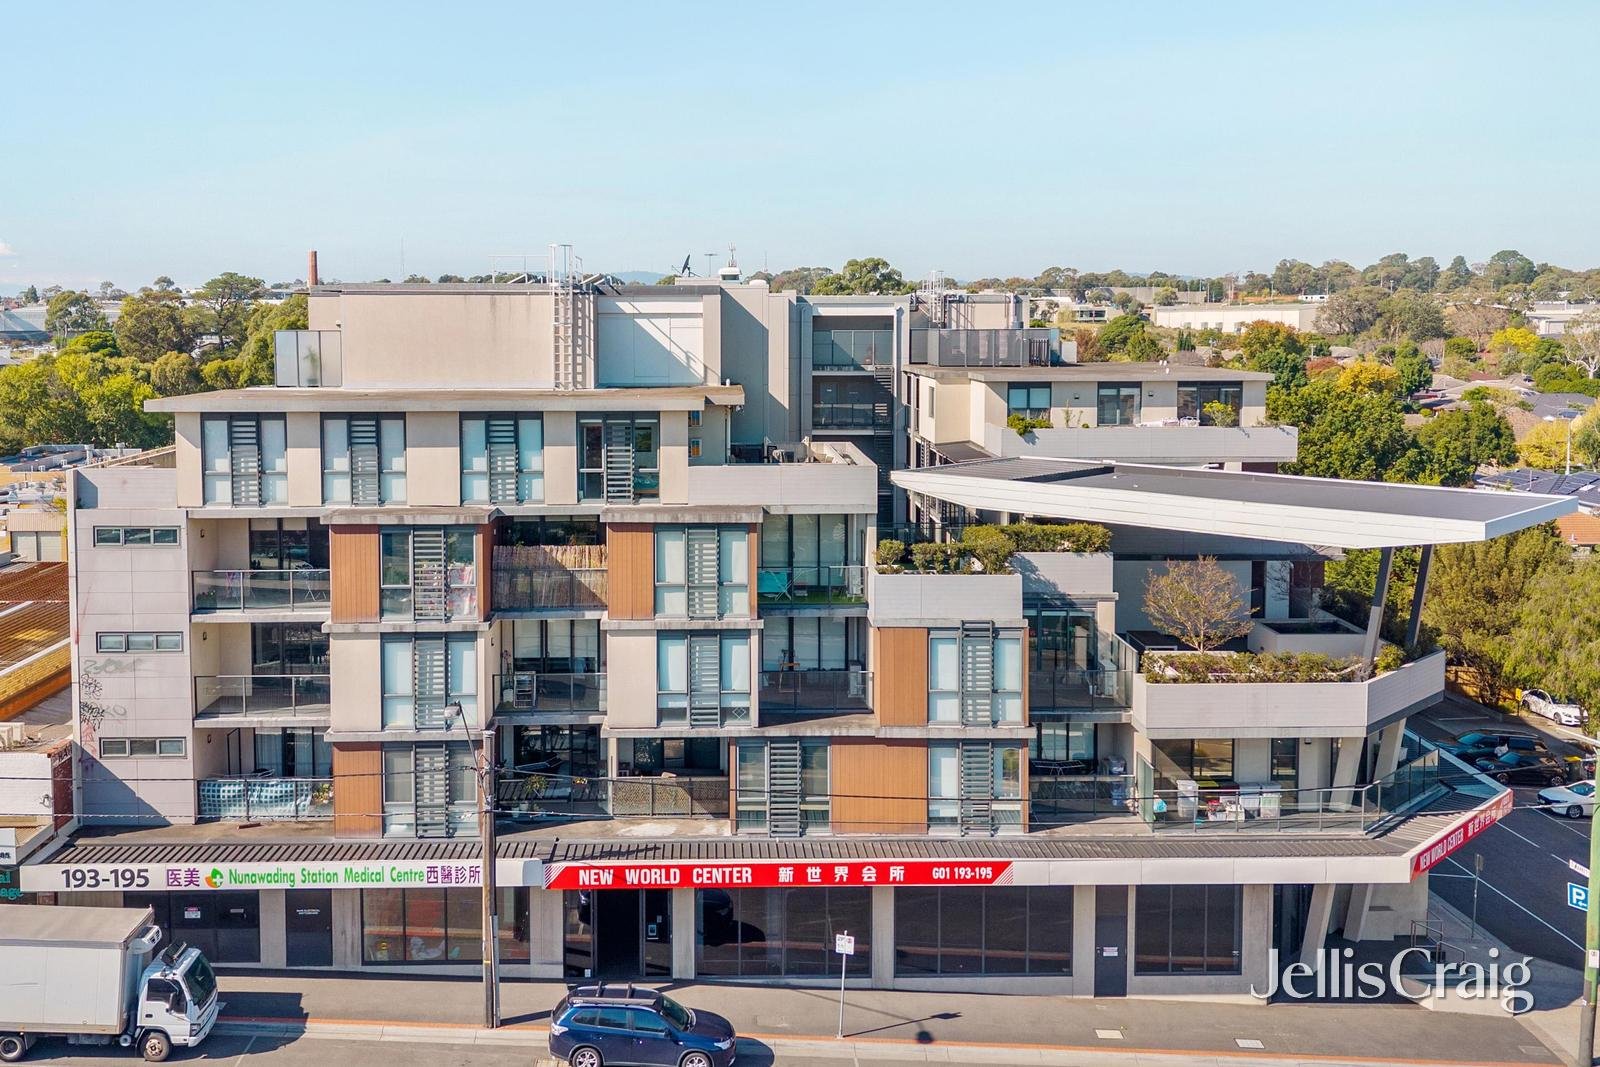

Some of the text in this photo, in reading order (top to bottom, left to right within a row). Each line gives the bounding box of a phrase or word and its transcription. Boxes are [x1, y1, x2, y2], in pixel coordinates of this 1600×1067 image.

[61, 868, 149, 888] 193-195
[166, 867, 200, 887] 医美
[229, 866, 424, 887] Nunawading Station Medical Centre
[426, 865, 481, 885] 西醫診所
[579, 867, 752, 886] NEW WORLD CENTER
[778, 866, 905, 883] 新世界会所
[932, 867, 992, 880] G01 193-195
[1572, 887, 1586, 904] P
